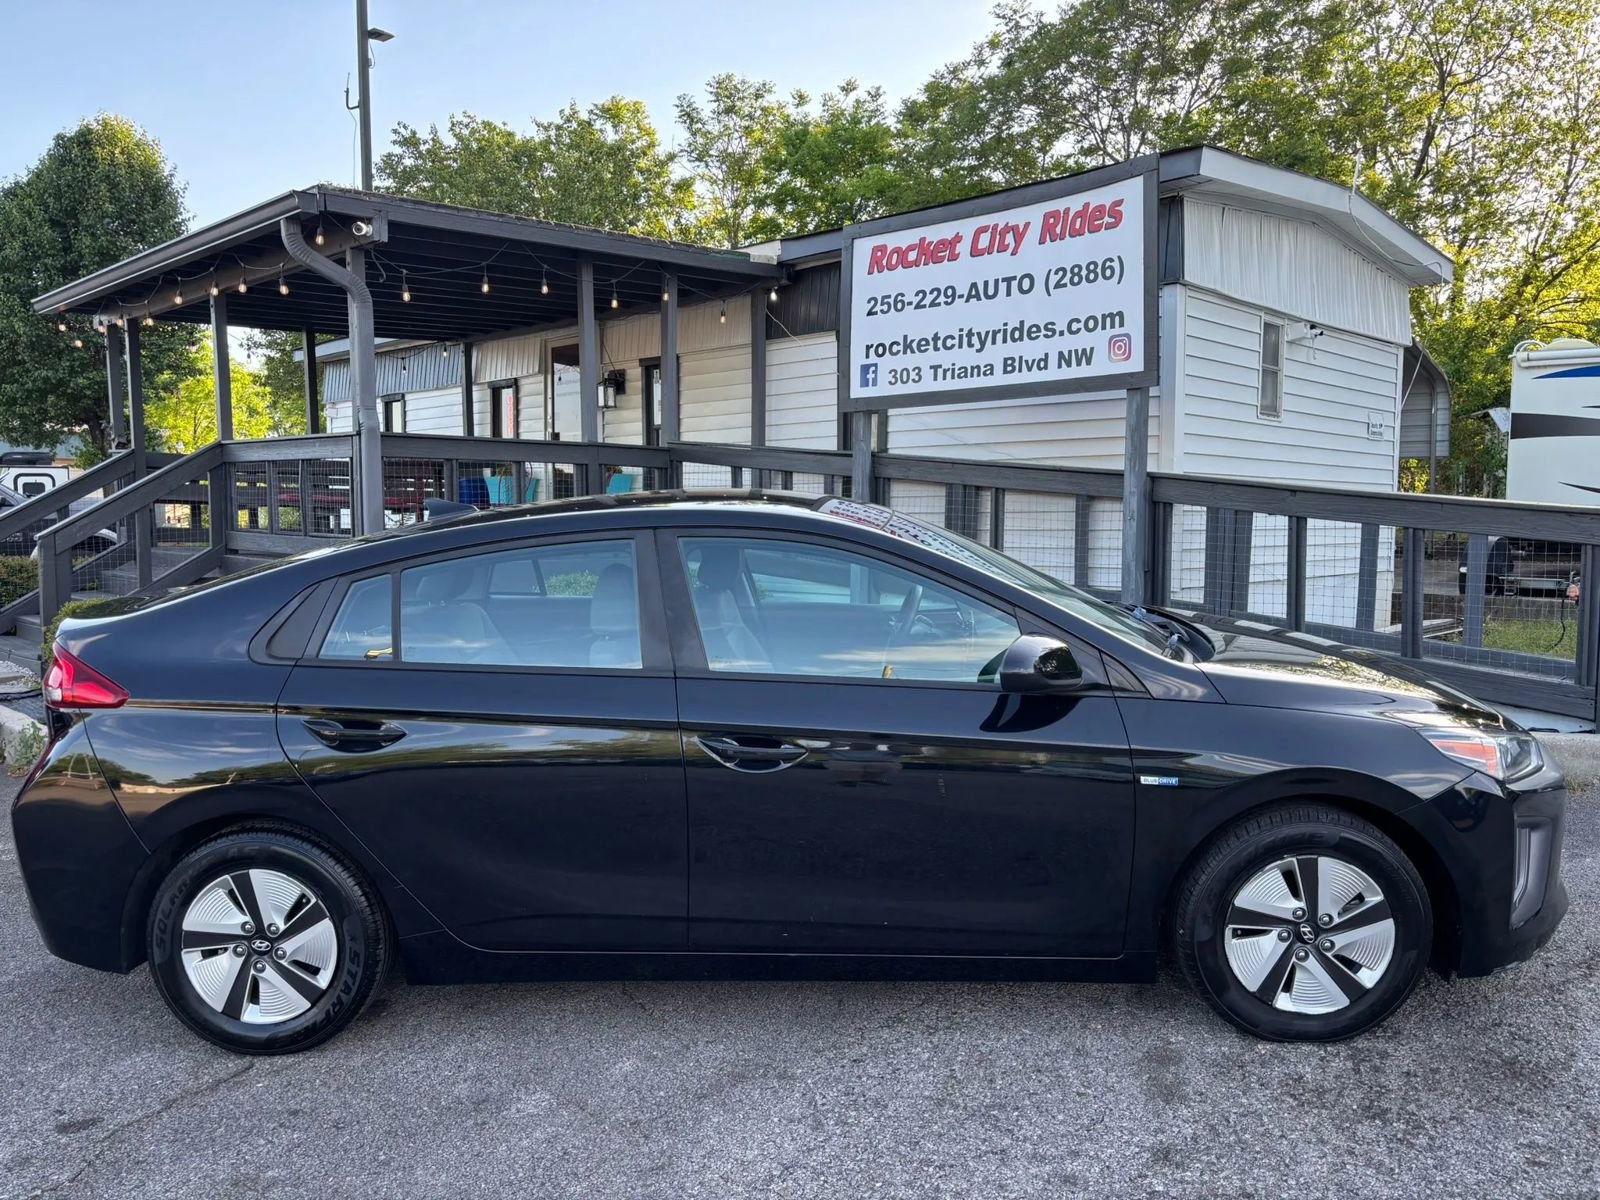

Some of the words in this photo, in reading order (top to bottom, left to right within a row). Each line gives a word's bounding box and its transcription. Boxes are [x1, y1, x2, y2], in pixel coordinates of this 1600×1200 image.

[867, 232, 964, 275] Rocket
[969, 222, 1031, 256] City
[1038, 198, 1125, 245] Rides
[866, 272, 1036, 317] 256-229-AUTO
[1044, 255, 1126, 297] (2886)
[864, 310, 1126, 360] rocketcityrides.com
[888, 366, 923, 387] 303
[930, 360, 995, 383] Triana
[1002, 352, 1050, 375] Blvd
[1057, 347, 1095, 370] NW
